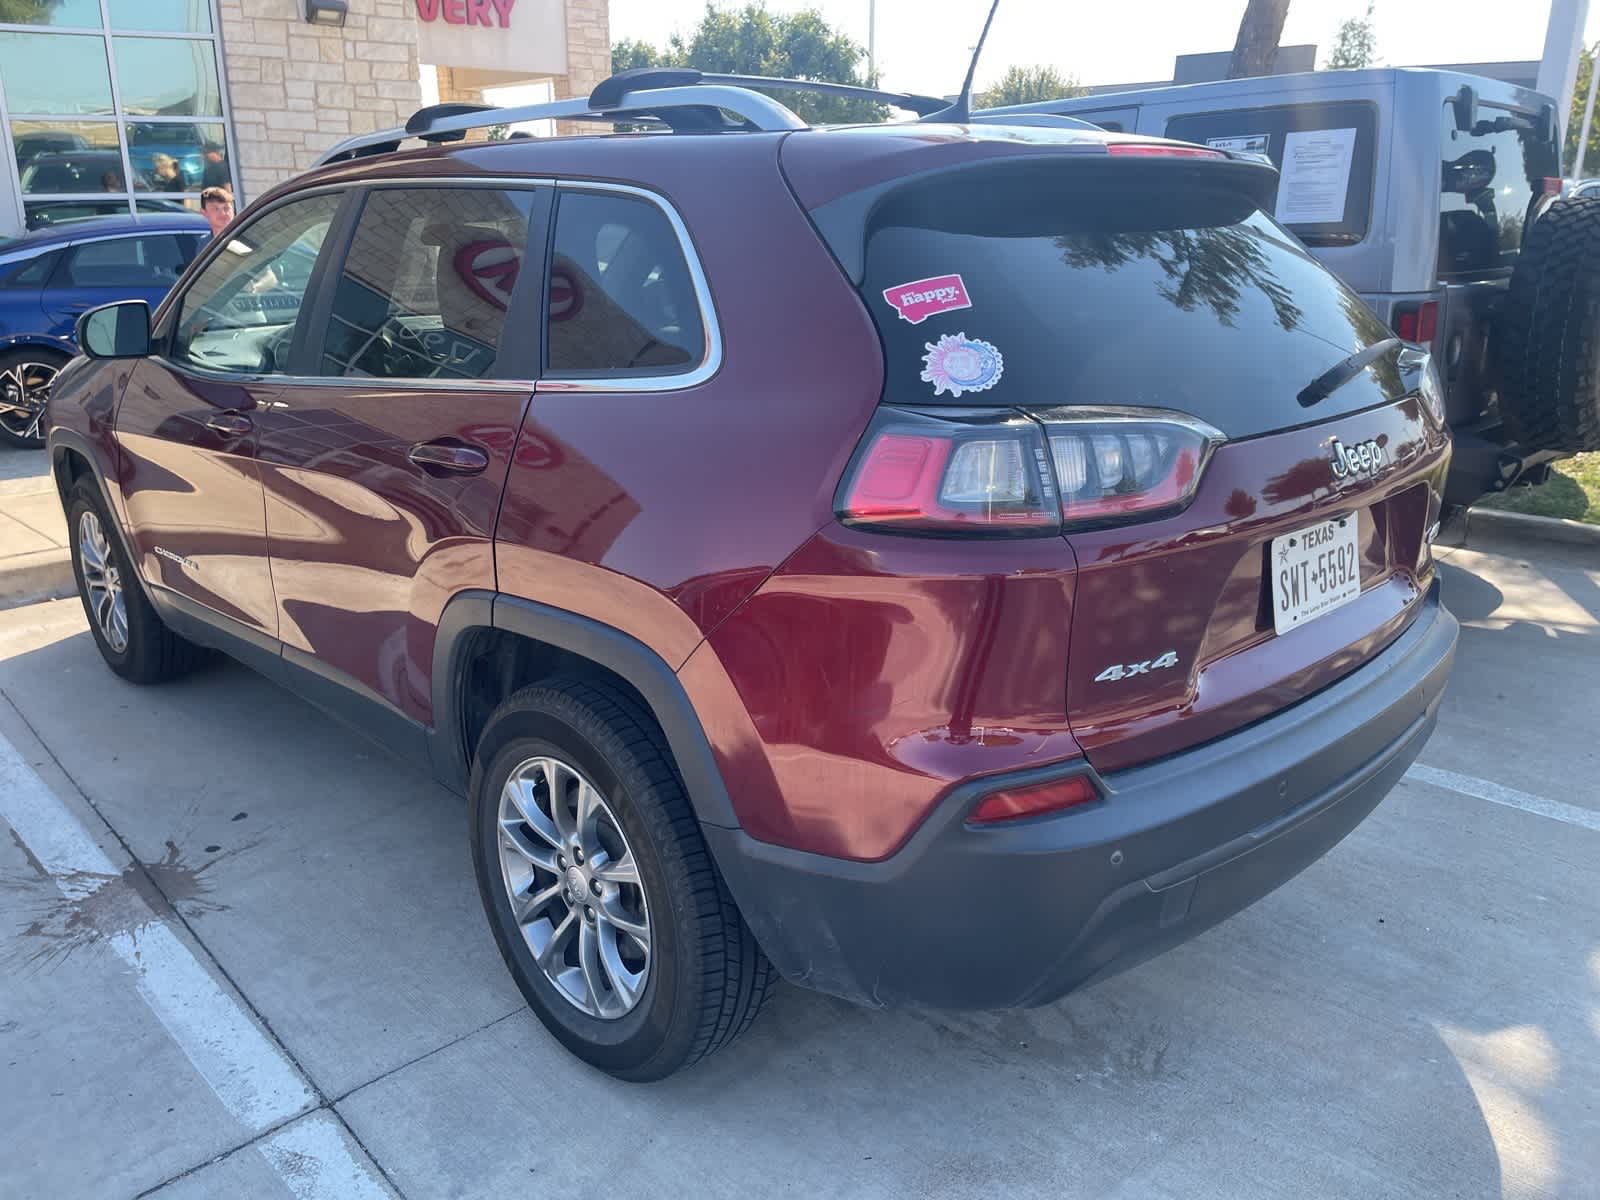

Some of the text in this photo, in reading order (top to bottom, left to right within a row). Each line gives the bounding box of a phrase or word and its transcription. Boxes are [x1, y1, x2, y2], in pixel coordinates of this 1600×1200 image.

[1330, 439, 1382, 480] Jeep
[1302, 524, 1334, 551] TEXAS
[1094, 650, 1179, 682] 4x4
